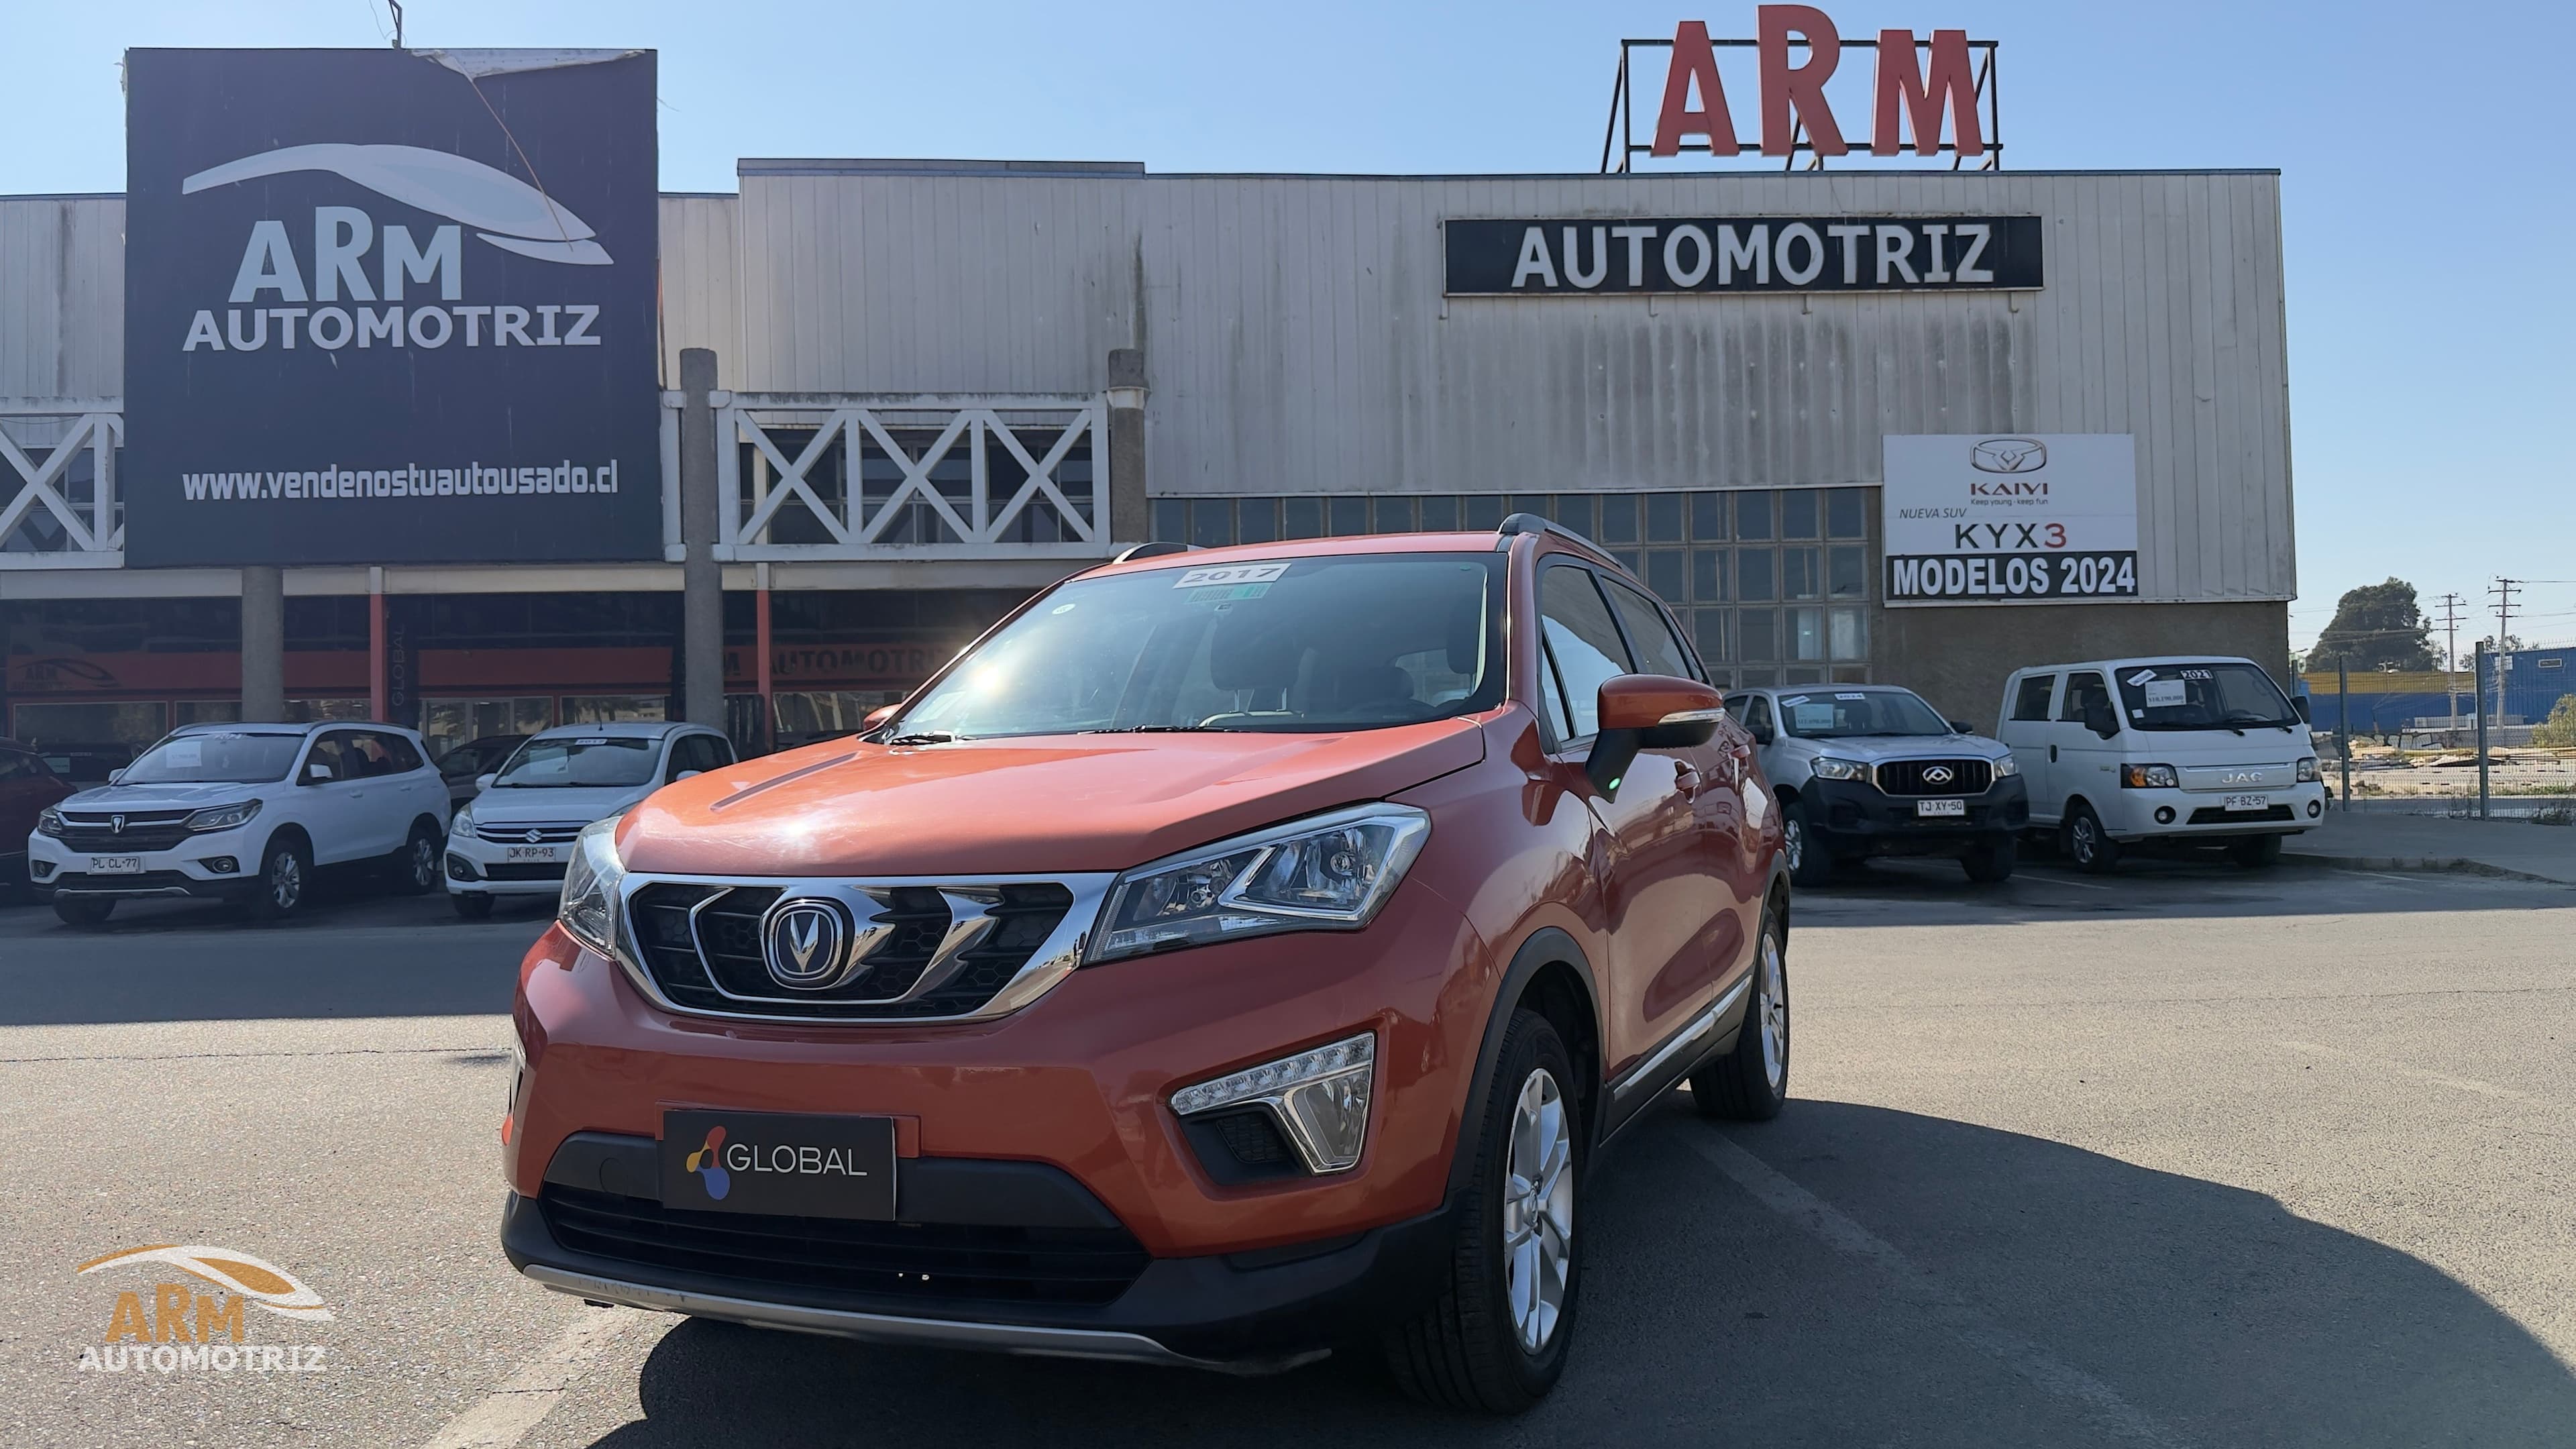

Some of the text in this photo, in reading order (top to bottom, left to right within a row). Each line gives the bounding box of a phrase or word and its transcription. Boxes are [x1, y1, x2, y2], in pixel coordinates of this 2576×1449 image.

[1650, 4, 1984, 158] ARM
[228, 206, 462, 303] ARM
[1511, 221, 1994, 289] AUTOMOTRIZ
[182, 304, 601, 352] AUTOMOTRIZ
[182, 459, 619, 502] www.vendenostuautousado.cl
[1970, 482, 2048, 495] KAIYI
[1899, 508, 1968, 519] NUEVA SUV
[2017, 498, 2035, 506] keep
[1955, 523, 2067, 549] KYX3
[1184, 568, 1281, 584] 2017
[1893, 557, 2135, 596] MODELOS 2024
[2184, 670, 2212, 679] 2021
[2222, 771, 2263, 784] JAC
[727, 1143, 867, 1177] GLOBAL
